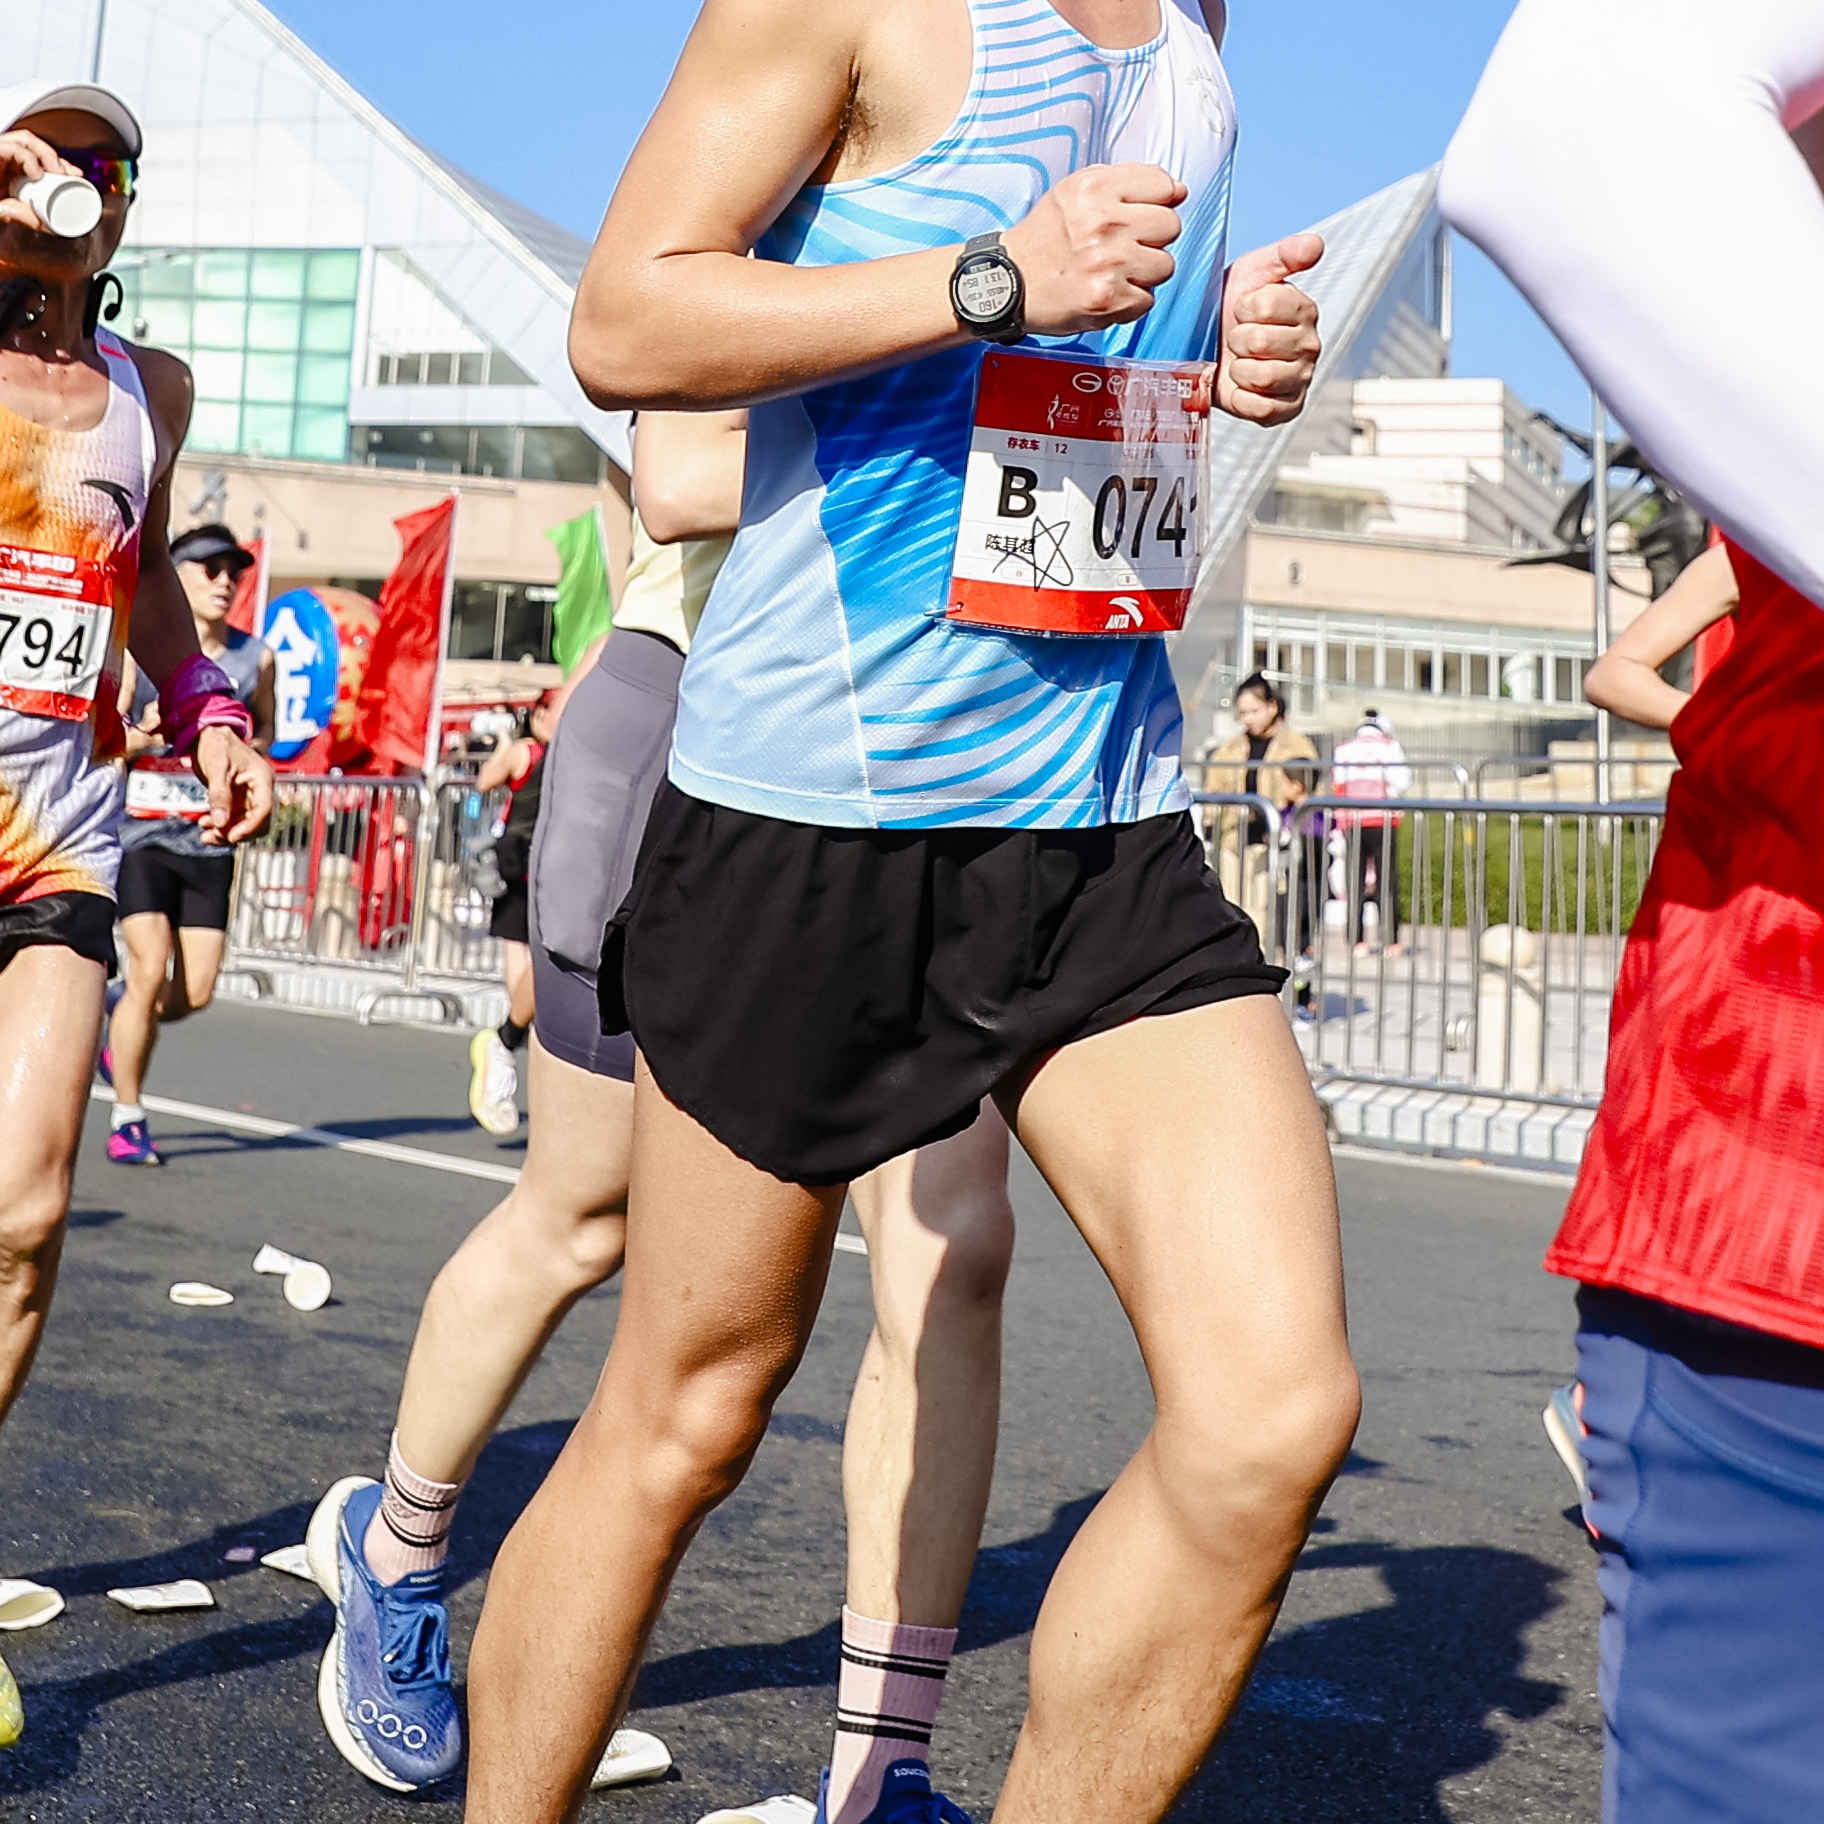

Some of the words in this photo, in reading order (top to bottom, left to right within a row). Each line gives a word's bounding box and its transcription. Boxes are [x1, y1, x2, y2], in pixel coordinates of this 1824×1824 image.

[1125, 376, 1194, 399] 广汽丰田
[1007, 436, 1040, 451] 存衣车
[1054, 443, 1067, 454] 12
[997, 465, 1038, 519] B
[1093, 475, 1197, 560] 074
[1105, 614, 1130, 629] ANTA
